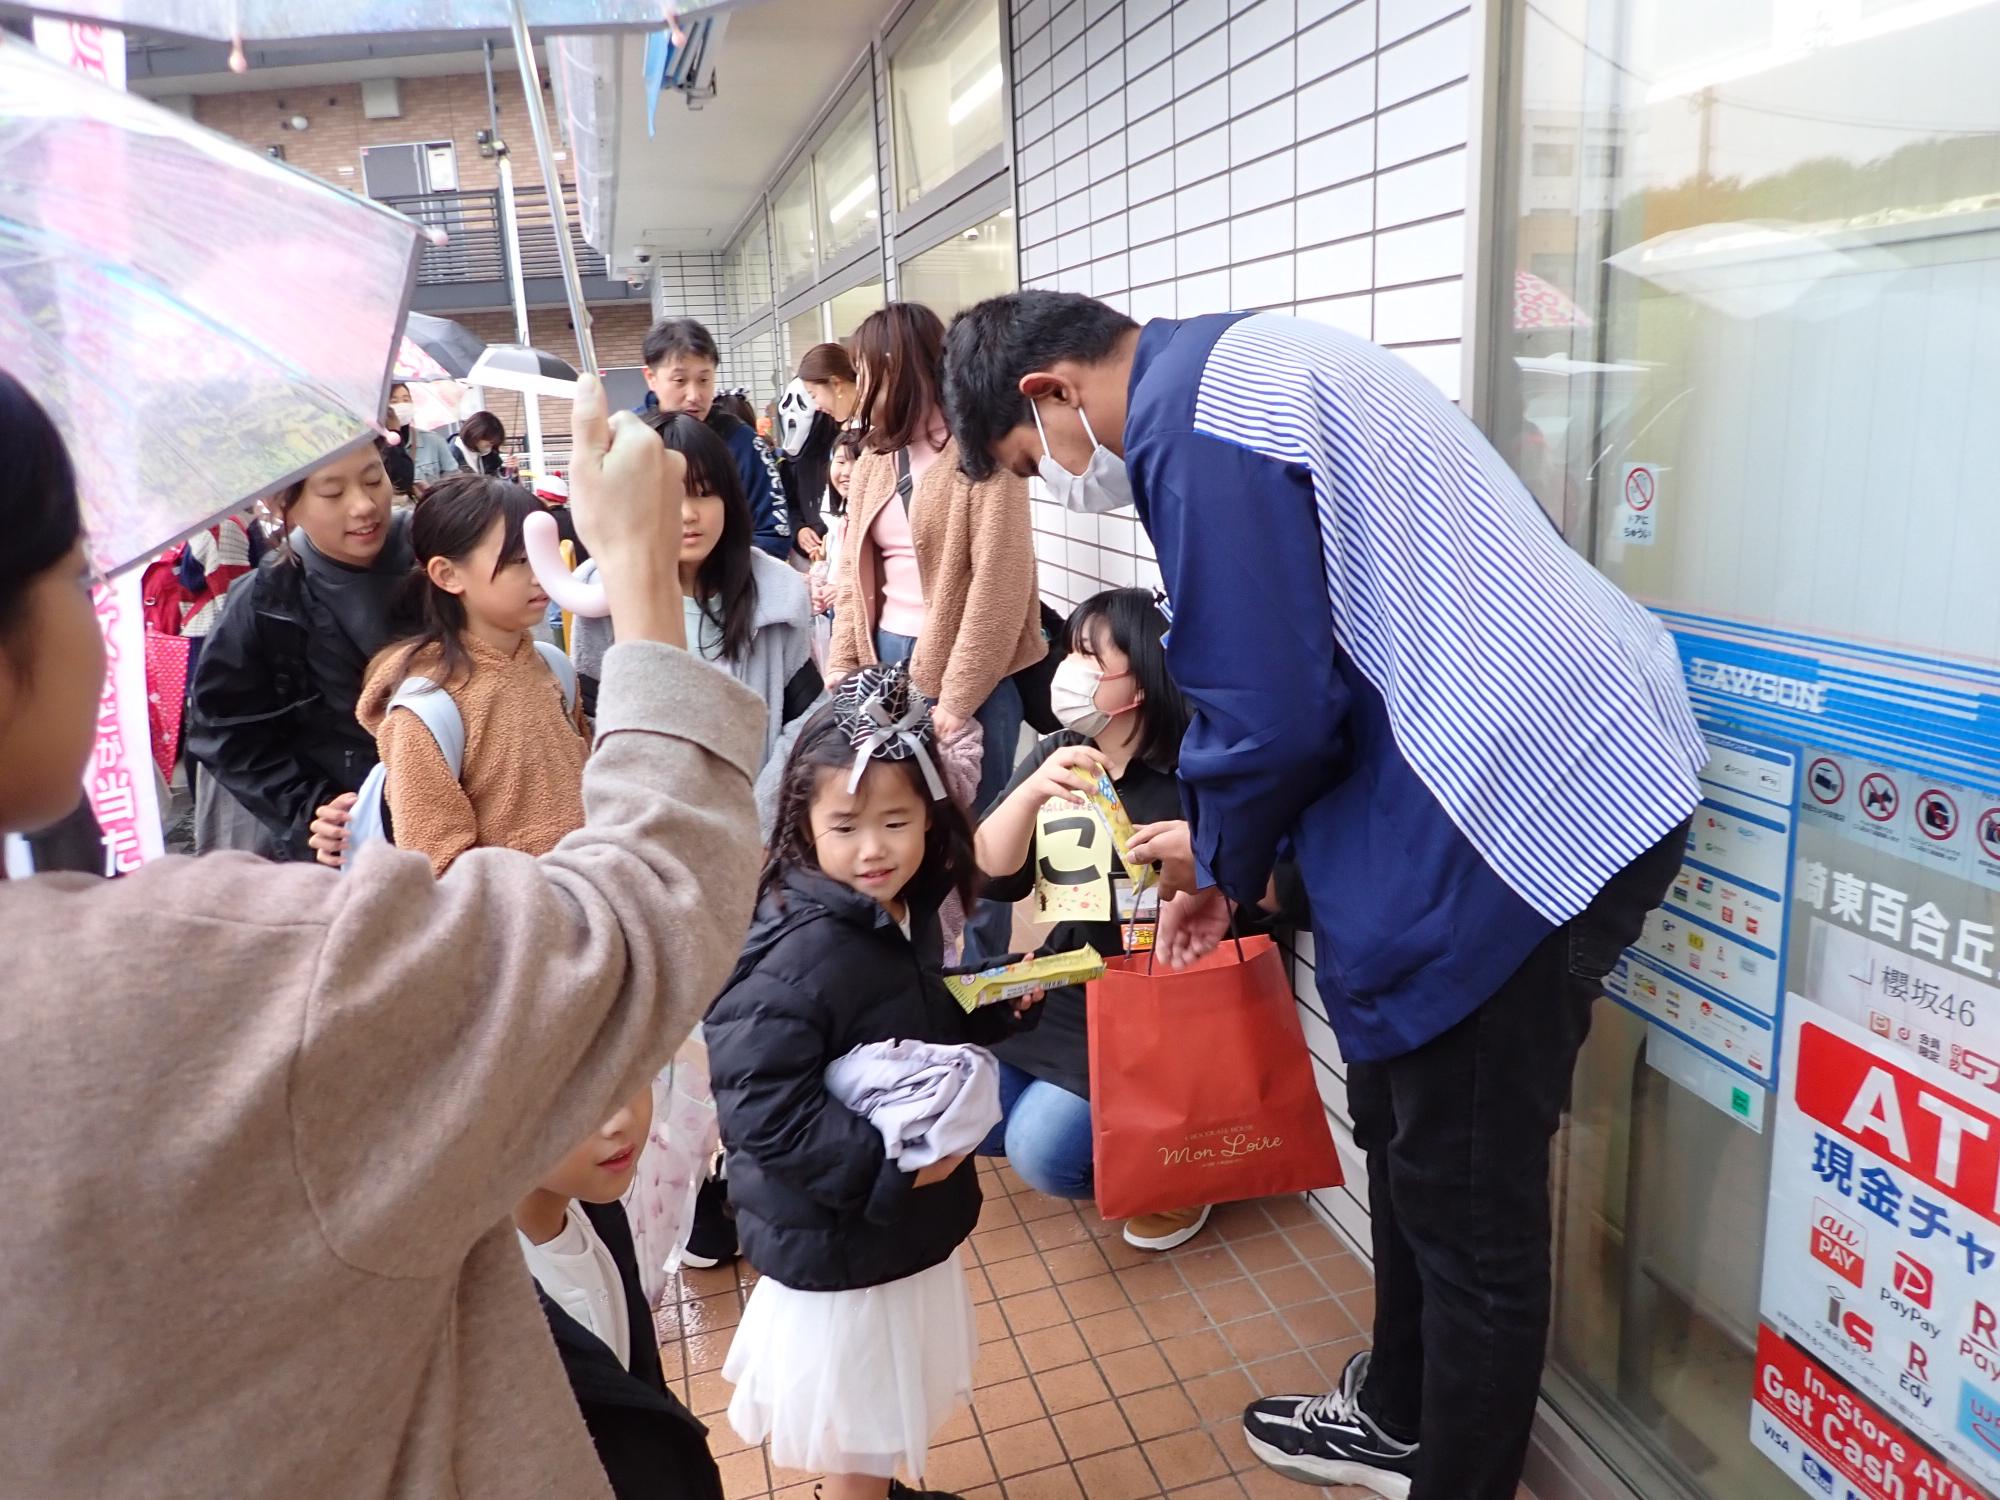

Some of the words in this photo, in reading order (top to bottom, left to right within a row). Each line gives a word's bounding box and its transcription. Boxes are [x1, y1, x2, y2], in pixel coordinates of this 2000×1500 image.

[1691, 657, 1827, 713] LAWSON
[1039, 816, 1102, 886] こ
[1795, 857, 2000, 979] 崎東百合丘
[1158, 1147, 1217, 1166] Mon
[1222, 1133, 1283, 1157] Loire
[1842, 1066, 2000, 1215] AT
[1819, 1237, 1856, 1271] PAY
[1820, 1215, 1859, 1247] au
[1880, 1287, 1942, 1340] PayPay
[1803, 1366, 1906, 1463] In-Store
[1900, 1373, 1933, 1408] Edy
[1762, 1419, 1790, 1453] VISA
[1763, 1364, 1815, 1427] Get
[1823, 1413, 1905, 1500] Cash
